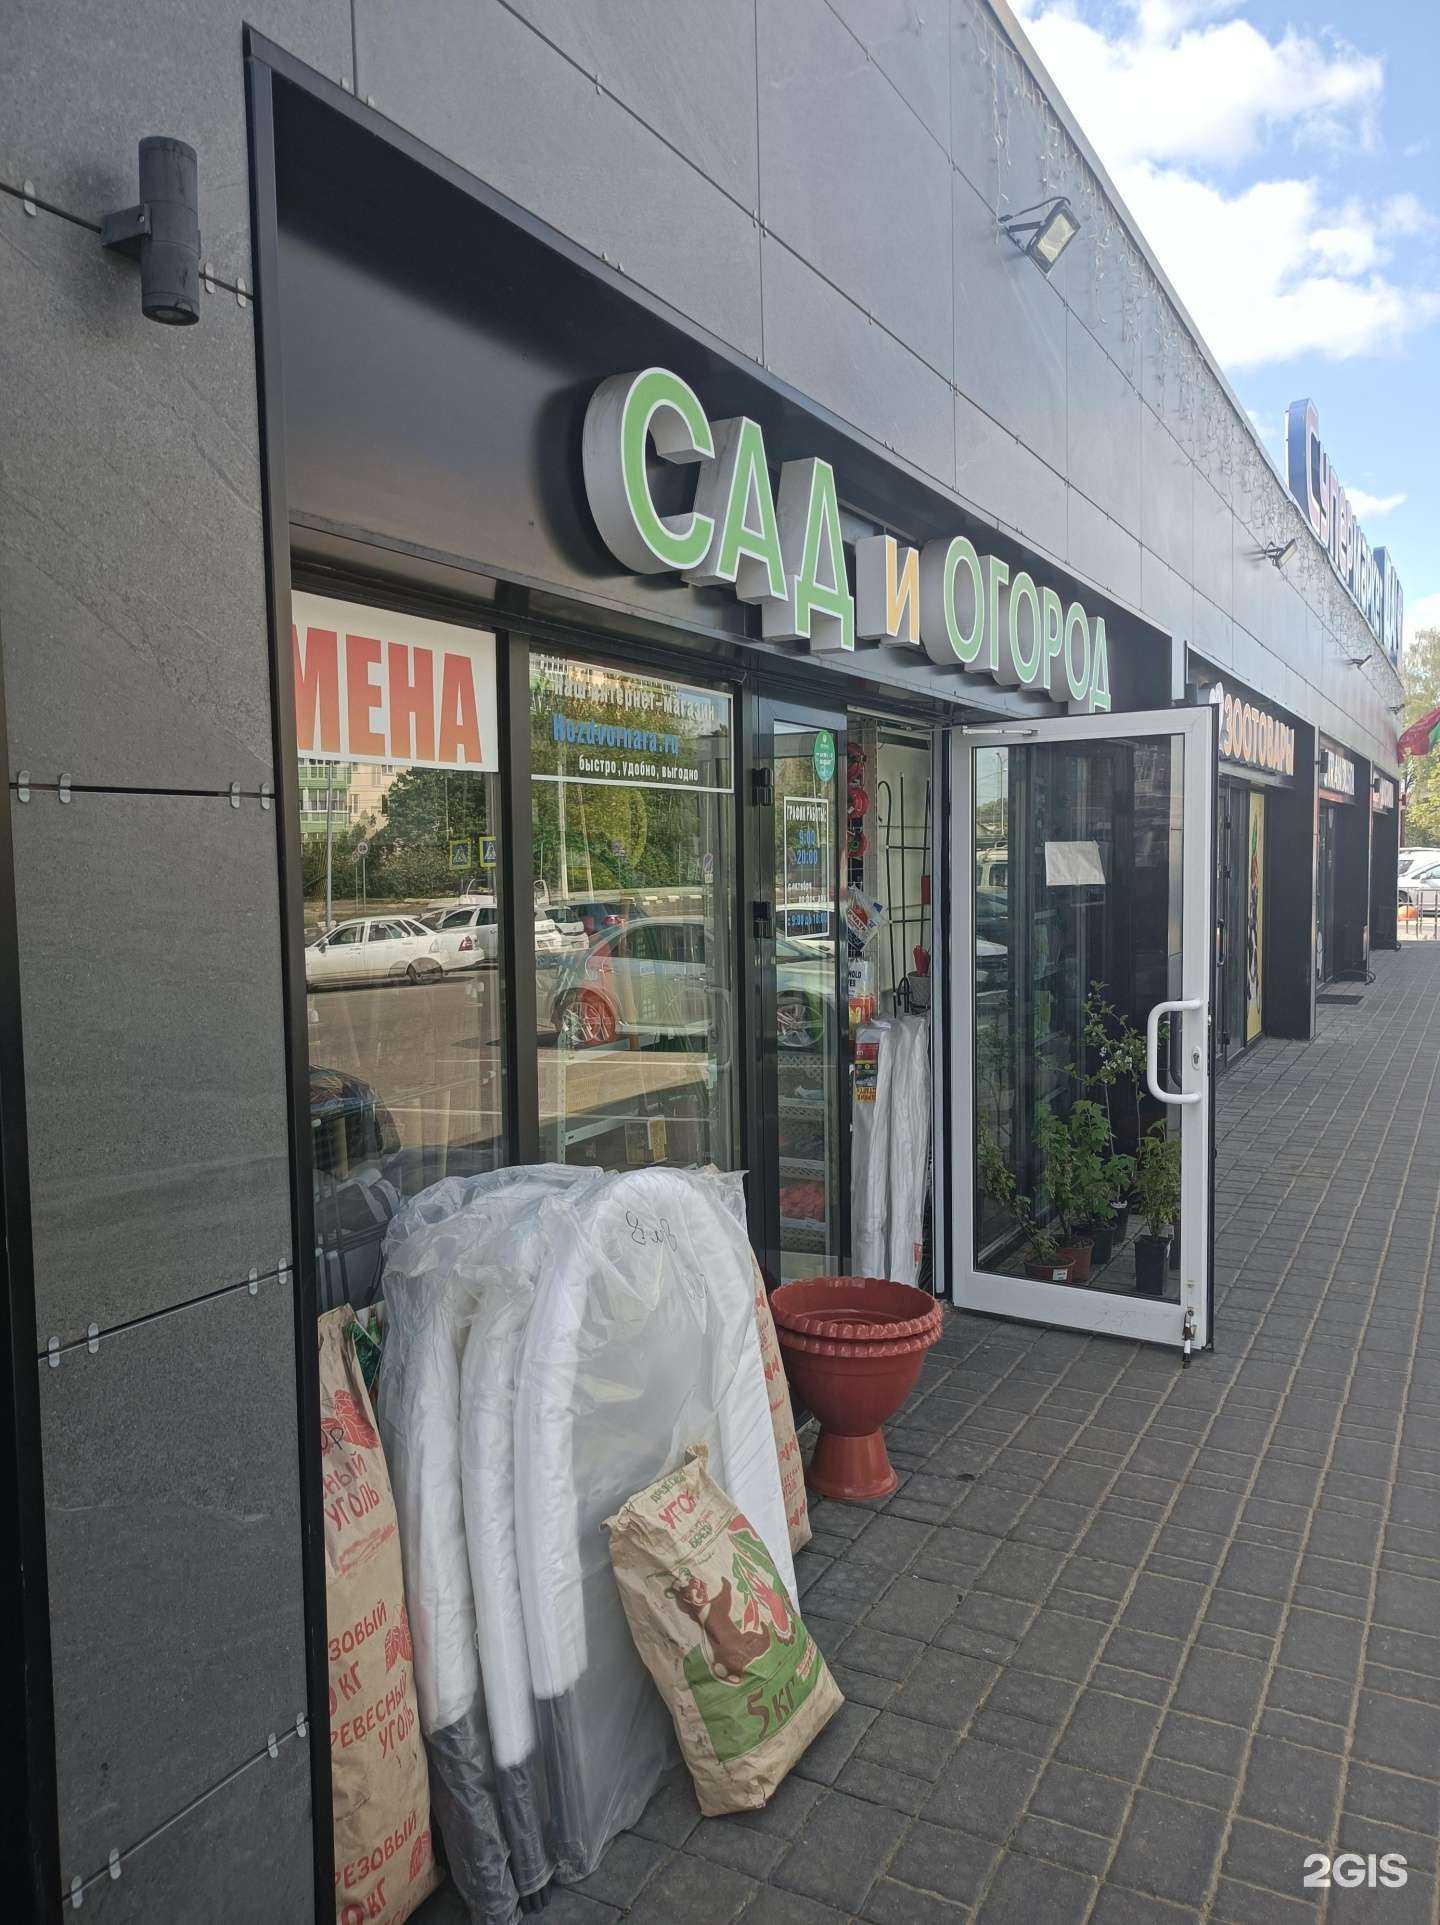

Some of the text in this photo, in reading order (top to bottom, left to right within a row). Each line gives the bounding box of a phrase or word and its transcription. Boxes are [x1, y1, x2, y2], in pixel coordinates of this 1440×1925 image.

[619, 366, 855, 652] САД
[943, 535, 1111, 713] ОГОРОД
[1223, 693, 1295, 776] ЗООТОВАРЫ
[661, 766, 699, 782] выгодно
[325, 1481, 380, 1531] УГОЛЬ
[329, 1598, 388, 1662] ЗОВЫЙ
[378, 1703, 415, 1759] УГОЛЬ
[746, 1687, 770, 1740] 5
